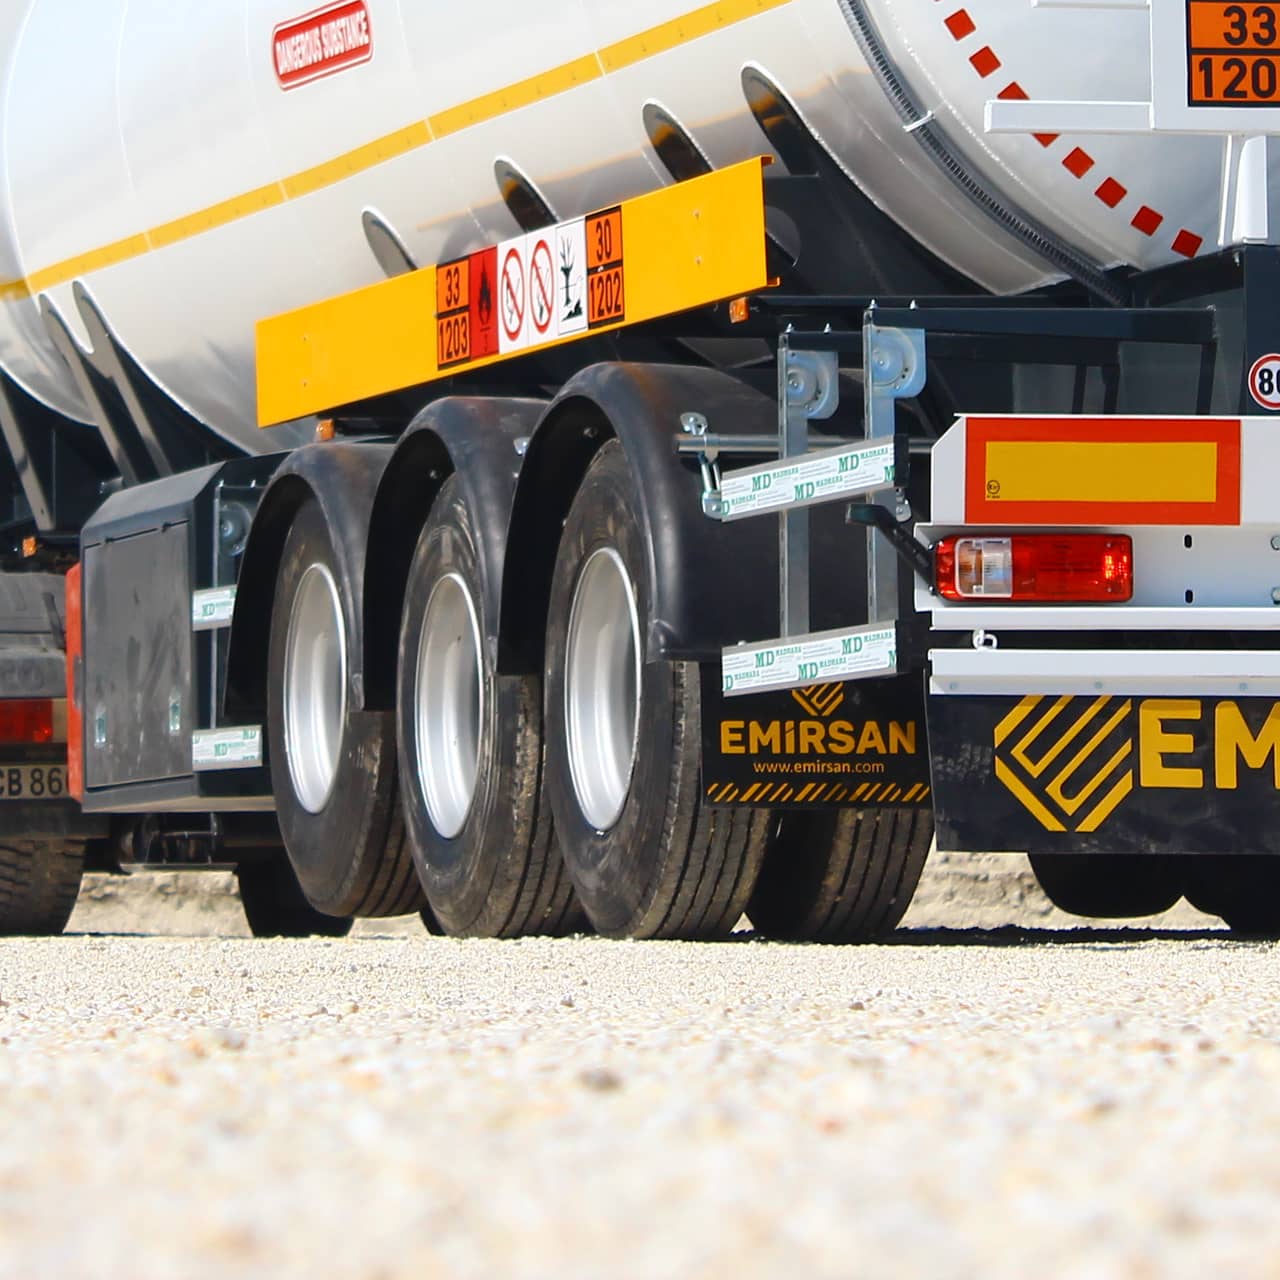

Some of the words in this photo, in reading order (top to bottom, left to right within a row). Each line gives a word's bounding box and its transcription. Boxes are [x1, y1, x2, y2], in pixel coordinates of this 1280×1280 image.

[1223, 5, 1277, 47] 33
[596, 219, 612, 262] 30
[446, 267, 460, 307] 33
[590, 271, 621, 319] 1202
[439, 317, 468, 361] 1203
[838, 454, 859, 473] MD
[752, 473, 771, 492] MD
[795, 482, 815, 500] MD
[842, 637, 863, 655] MD
[755, 651, 775, 668] MD
[798, 663, 818, 680] MD
[753, 759, 885, 774] www.emirsan.com
[30, 767, 69, 796] 86
